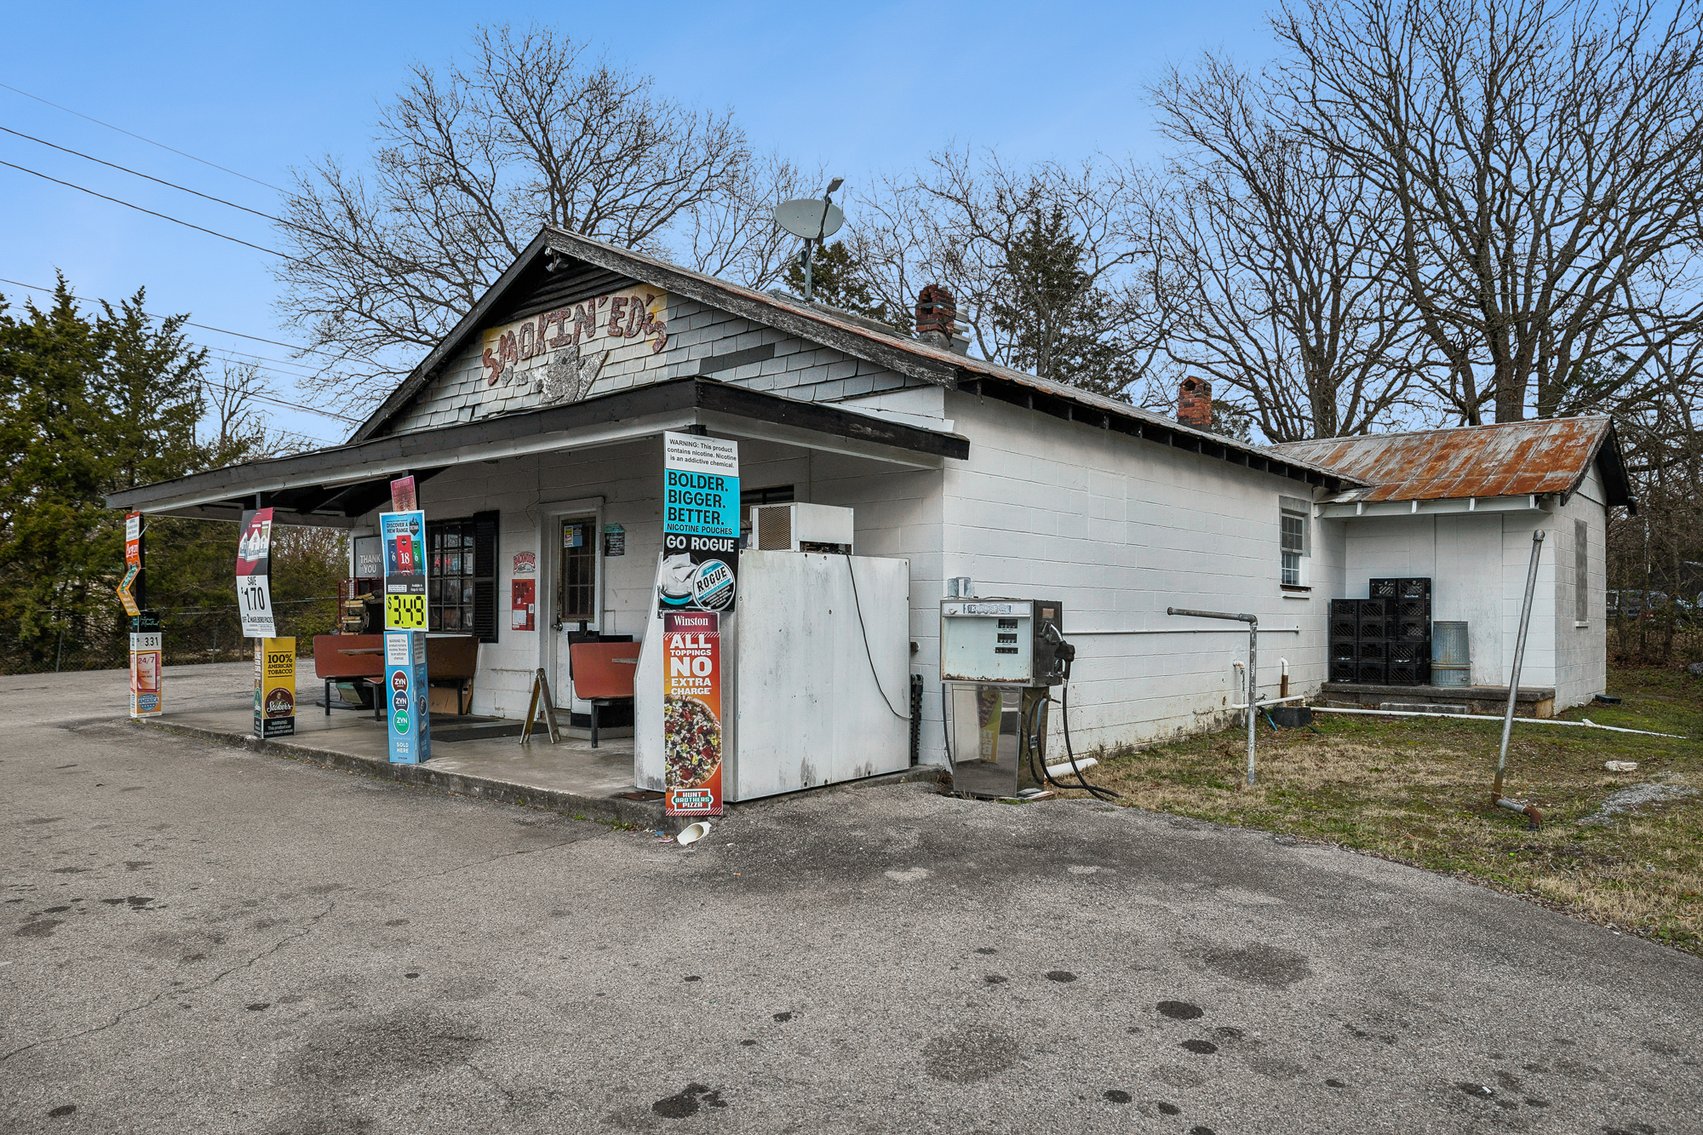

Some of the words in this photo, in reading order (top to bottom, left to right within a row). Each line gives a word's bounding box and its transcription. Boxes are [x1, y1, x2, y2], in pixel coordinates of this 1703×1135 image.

[669, 438, 700, 448] WARNING:
[712, 444, 733, 453] product
[667, 447, 691, 455] contains
[692, 450, 715, 458] nicotine.
[716, 453, 736, 461] Nicotine
[684, 456, 710, 465] addictive
[710, 459, 734, 468] chemical.
[668, 472, 728, 492] BOLDER.
[668, 489, 726, 508] BIGGER.
[668, 506, 724, 526] BETTER.
[666, 524, 699, 532] NICOTINE
[702, 526, 732, 535] POUCHES
[666, 535, 686, 548] GO
[690, 537, 734, 552] ROGUE
[360, 554, 381, 564] THANK
[401, 552, 410, 564] 18
[363, 565, 376, 573] YOU
[696, 566, 727, 592] ROGUE
[674, 615, 708, 626] Winston
[670, 634, 712, 649] ALL
[268, 654, 292, 663] 100%
[670, 656, 712, 677] NO
[671, 678, 711, 686] EXTRA
